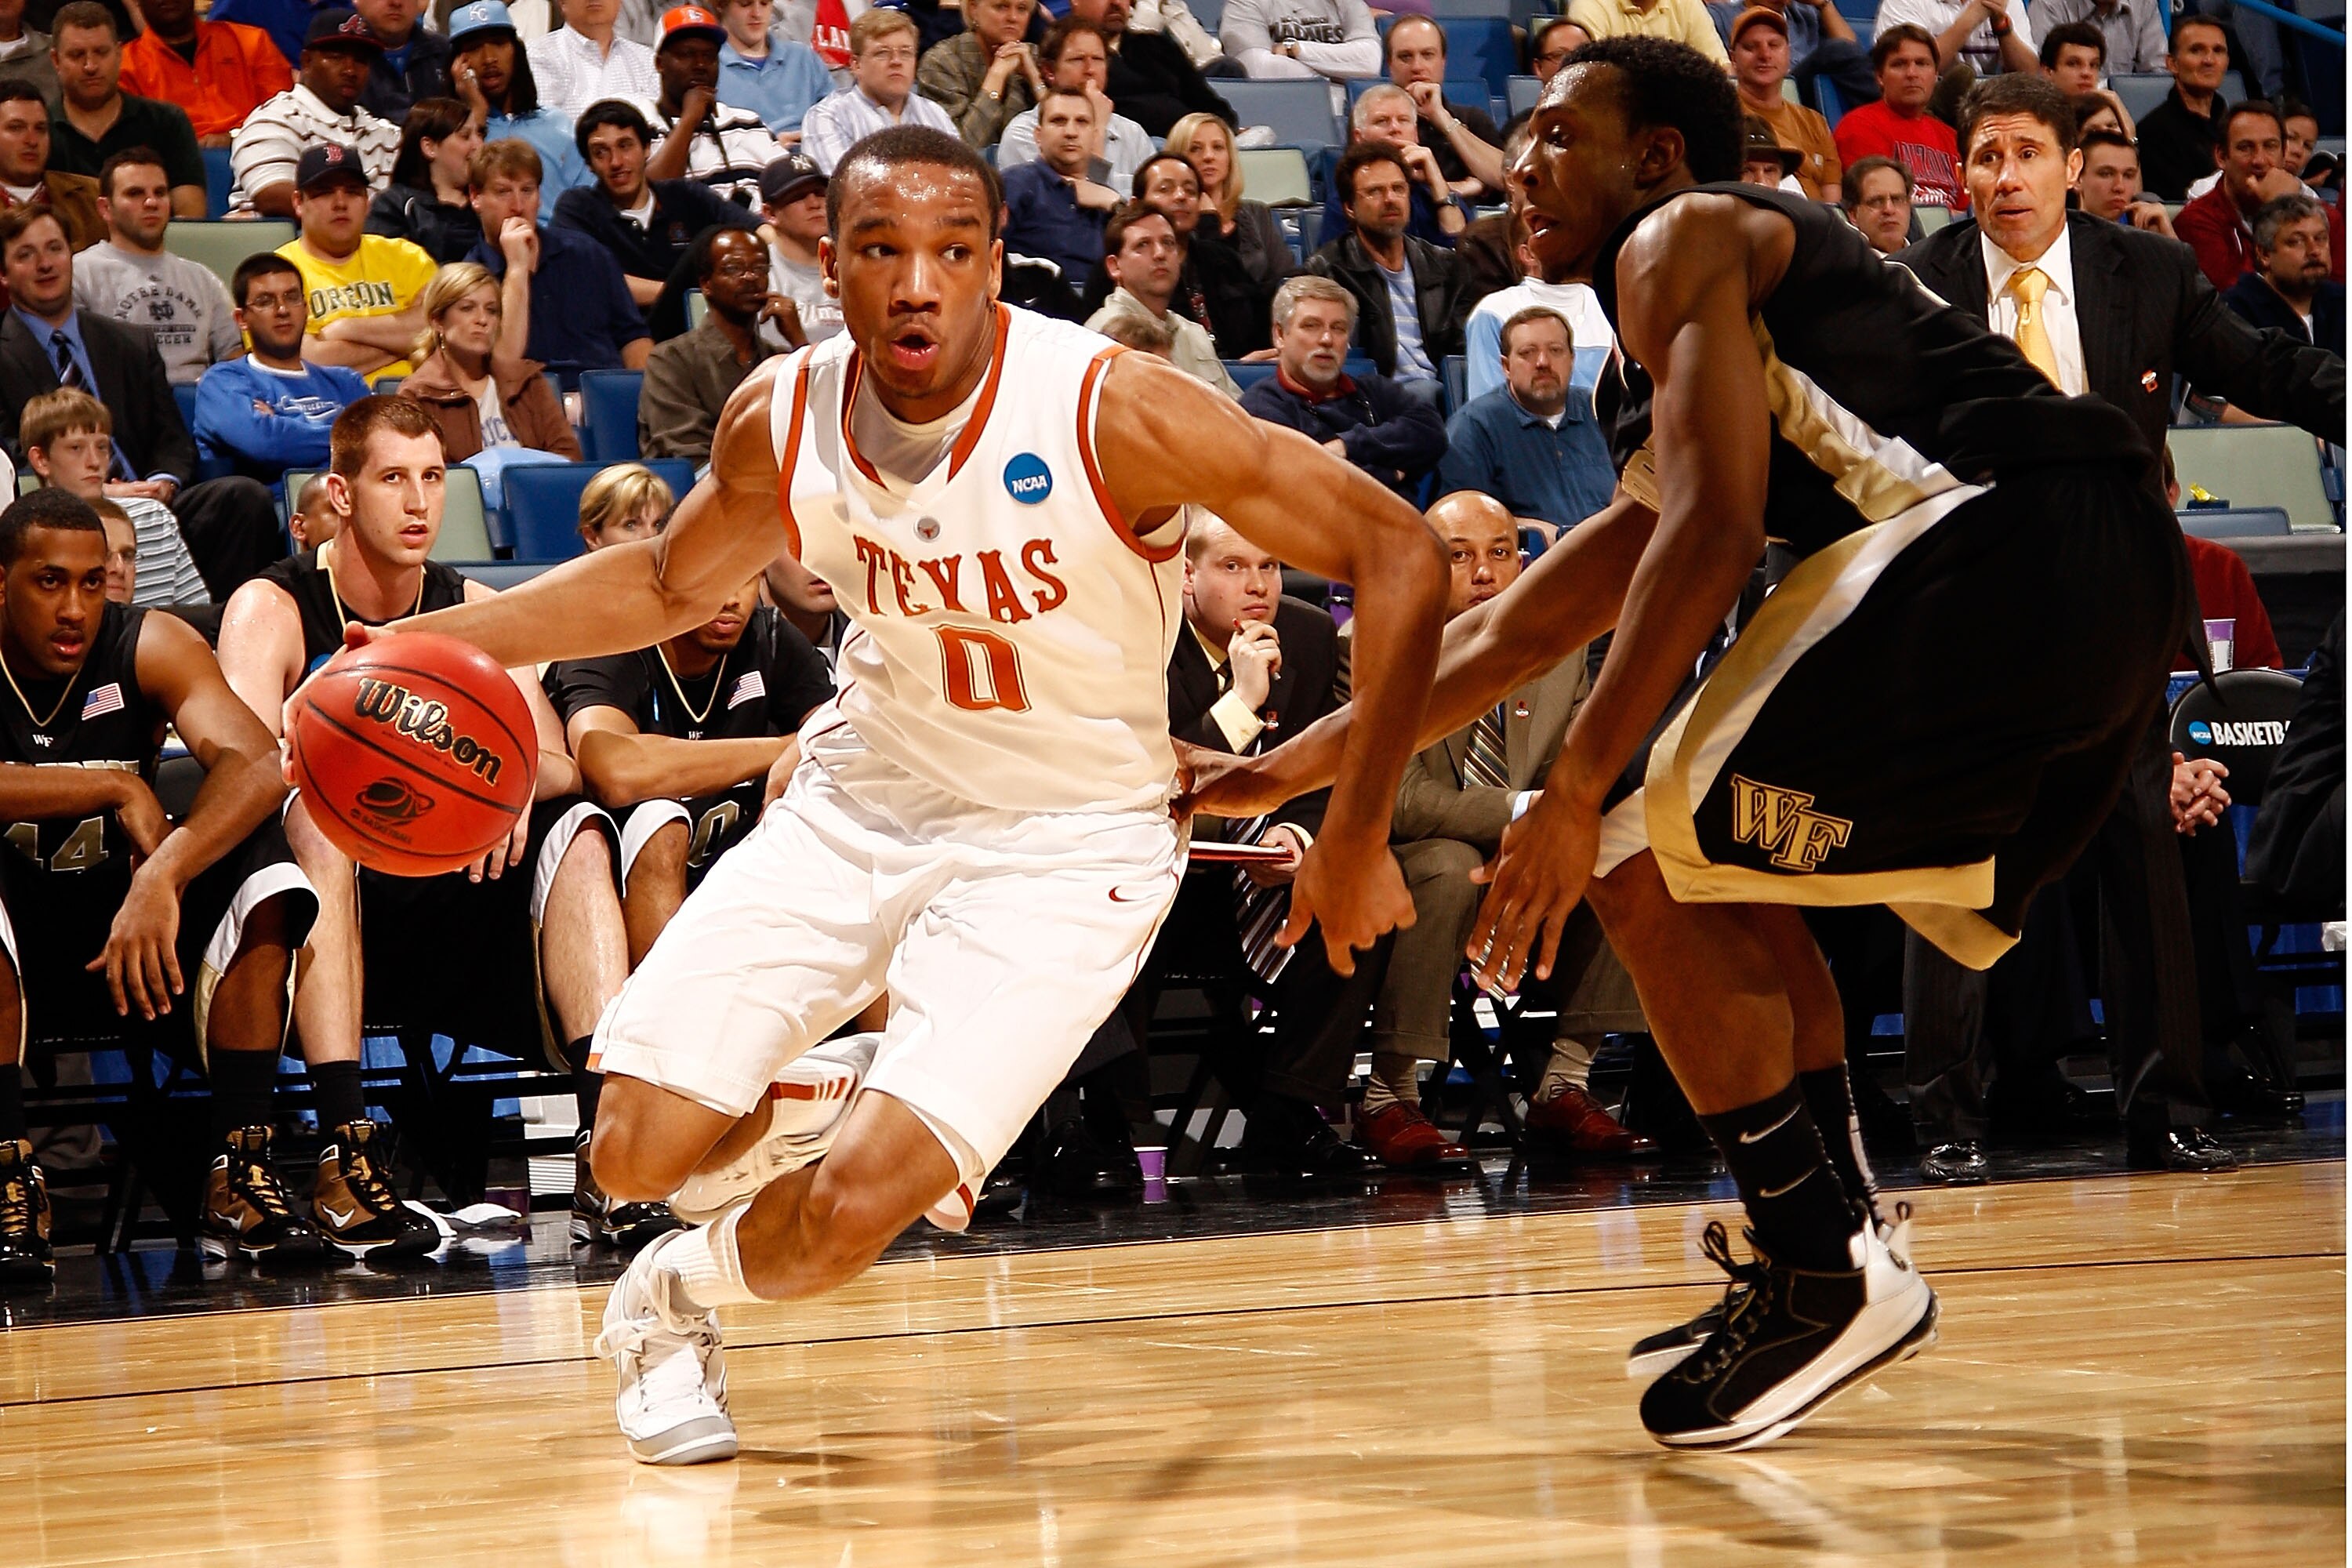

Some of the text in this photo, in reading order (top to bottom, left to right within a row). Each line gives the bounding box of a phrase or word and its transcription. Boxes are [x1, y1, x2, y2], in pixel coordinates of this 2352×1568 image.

[339, 13, 367, 34] A
[469, 4, 490, 22] KC
[324, 143, 343, 164] B
[790, 155, 812, 171] NY
[1011, 474, 1048, 495] NCAA
[853, 534, 1068, 625] TEXAS
[930, 623, 1033, 715] 0
[32, 734, 54, 747] WF
[354, 677, 503, 787] Wilson
[1730, 773, 1854, 873] WF
